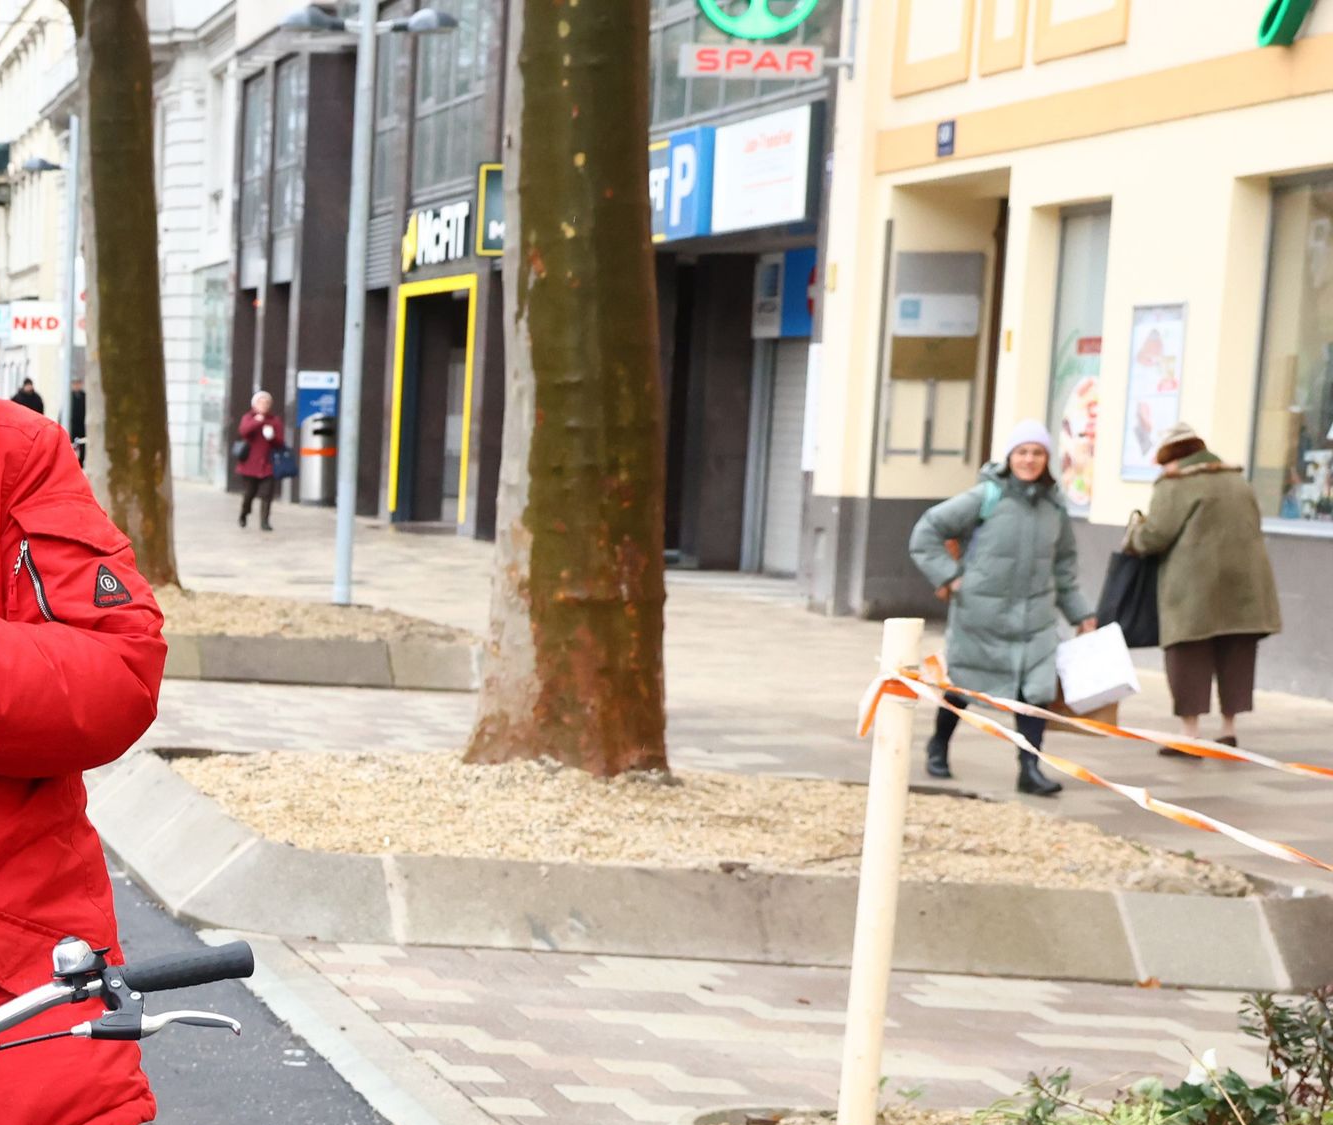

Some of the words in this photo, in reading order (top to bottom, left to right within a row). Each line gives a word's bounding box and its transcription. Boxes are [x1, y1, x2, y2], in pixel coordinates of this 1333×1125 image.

[695, 48, 816, 73] SPAR
[669, 144, 697, 227] P
[14, 316, 59, 330] NKD
